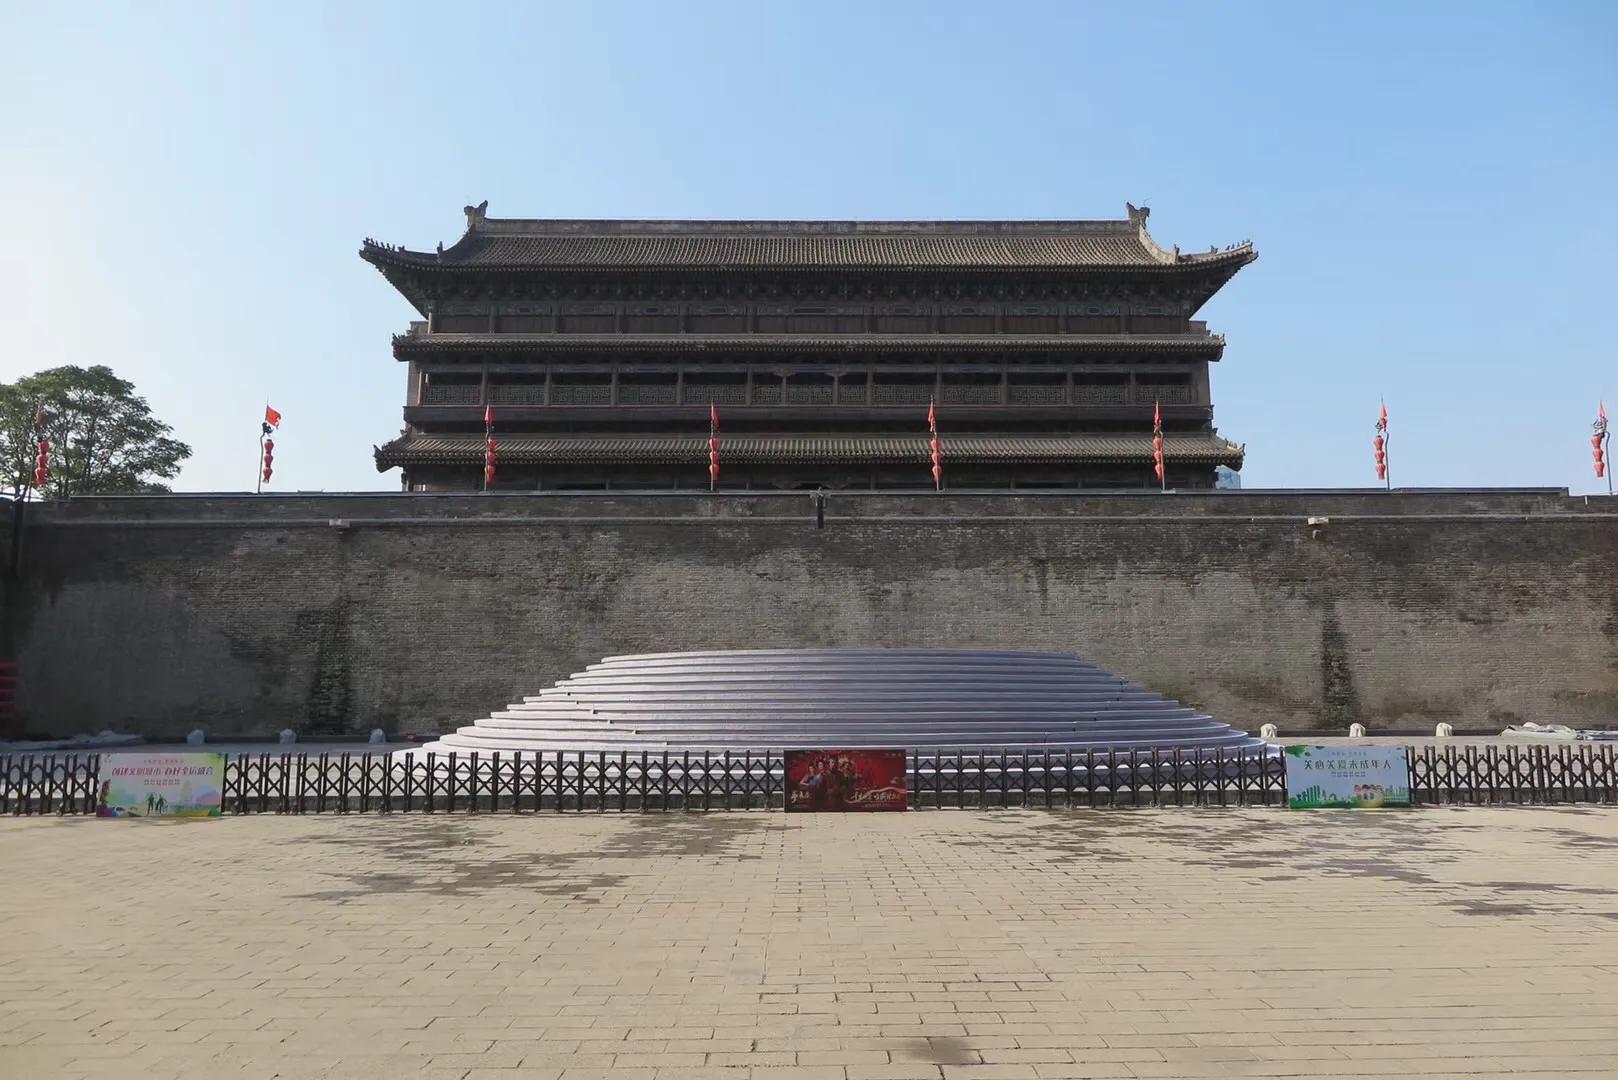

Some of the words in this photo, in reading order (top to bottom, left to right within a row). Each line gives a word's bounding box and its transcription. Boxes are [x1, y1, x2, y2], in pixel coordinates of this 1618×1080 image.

[1304, 759, 1392, 770] 关心关爱未成年人
